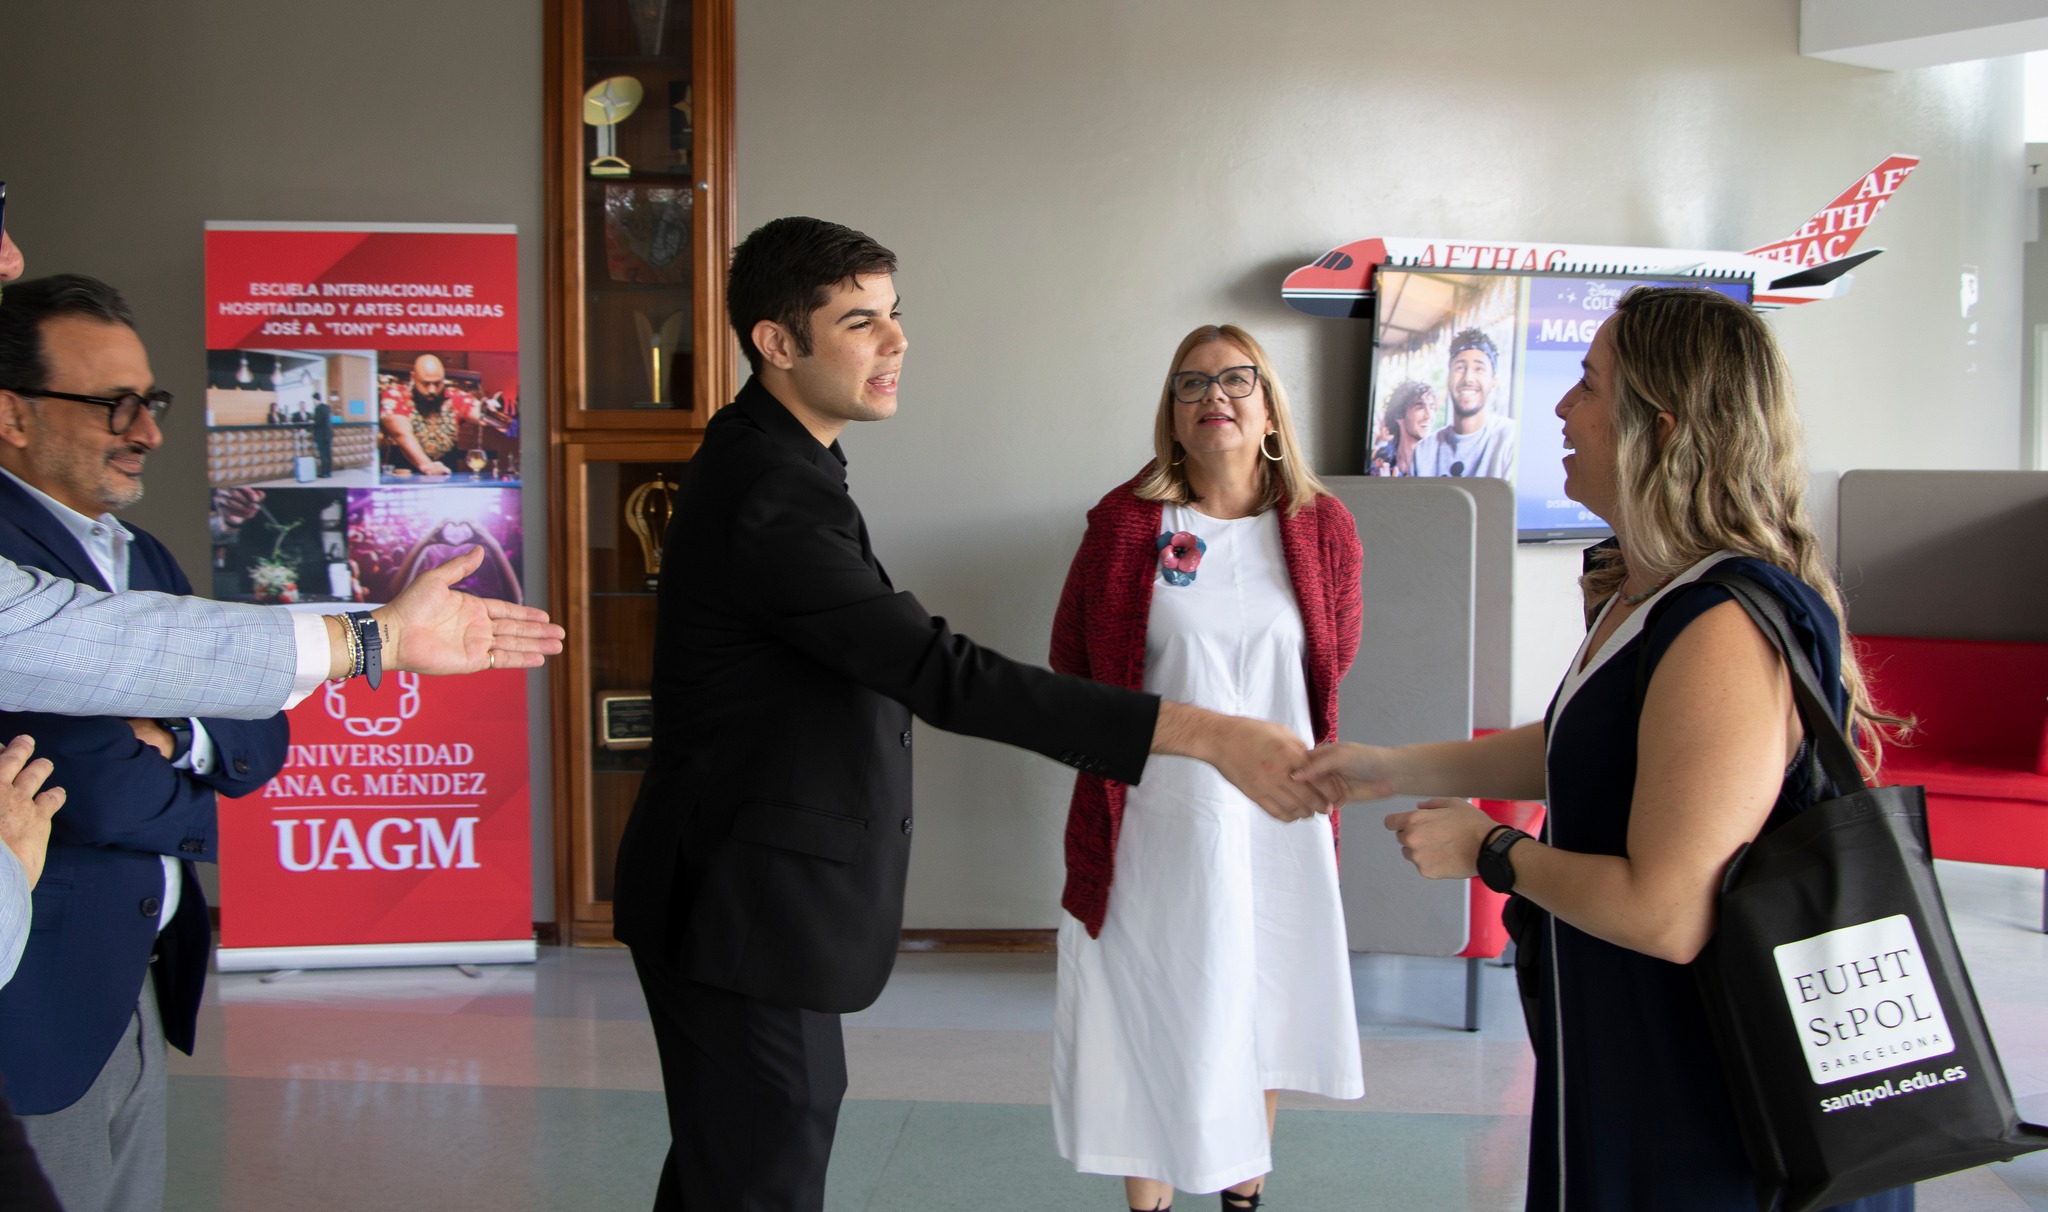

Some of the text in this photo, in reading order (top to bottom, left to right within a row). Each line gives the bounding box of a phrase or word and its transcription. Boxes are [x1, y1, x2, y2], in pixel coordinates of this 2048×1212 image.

[1852, 167, 1916, 200] AE
[249, 282, 475, 298] ESCUELA INTERNACIONAL DE
[218, 301, 504, 318] HOSPITALIDAD Y ARTES CULINARIAS
[261, 318, 465, 337] JOSÉ A. "TONY" SANTANA
[1540, 318, 1604, 344] MAG
[261, 768, 488, 799] ANA G. MÉNDEZ
[271, 816, 482, 873] UAGM
[1792, 948, 1912, 1004] EUHT
[1808, 993, 1933, 1048] StPOL
[1819, 1034, 1943, 1073] BARCELONA
[1819, 1065, 1968, 1113] santpol.edu.es
